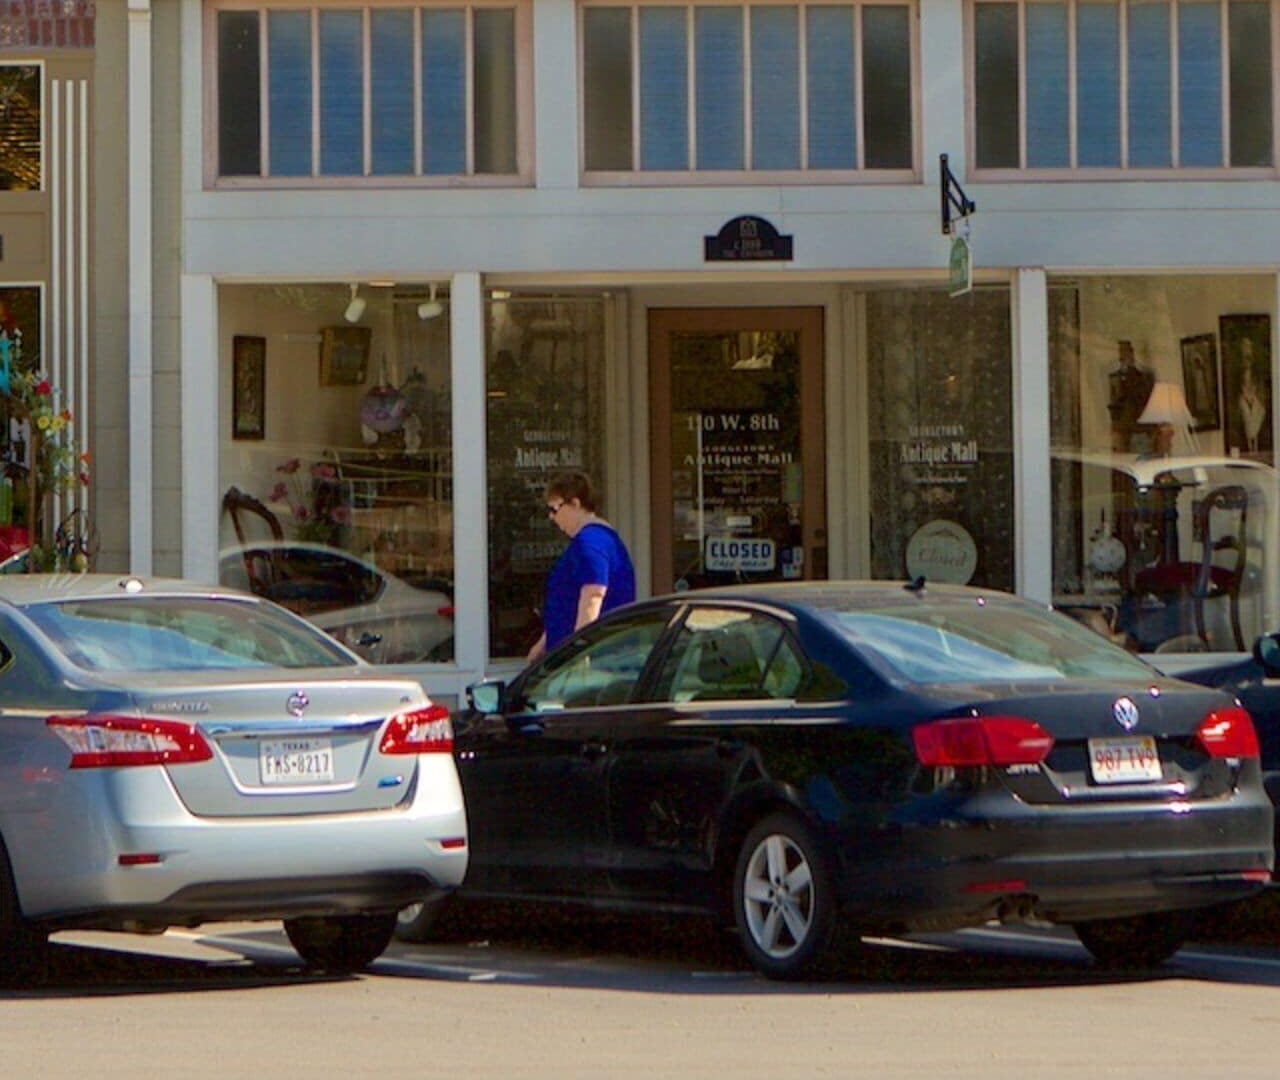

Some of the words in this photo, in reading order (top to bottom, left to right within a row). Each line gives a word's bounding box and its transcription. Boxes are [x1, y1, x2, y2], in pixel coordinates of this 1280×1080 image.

[720, 414, 746, 431] W.
[749, 413, 780, 432] 8th
[701, 444, 775, 453] EORGETOWN
[900, 441, 949, 467] Antique
[951, 440, 978, 462] Mall
[757, 452, 794, 465] Mall
[710, 542, 772, 559] CLOSED
[282, 741, 311, 751] TEXAS
